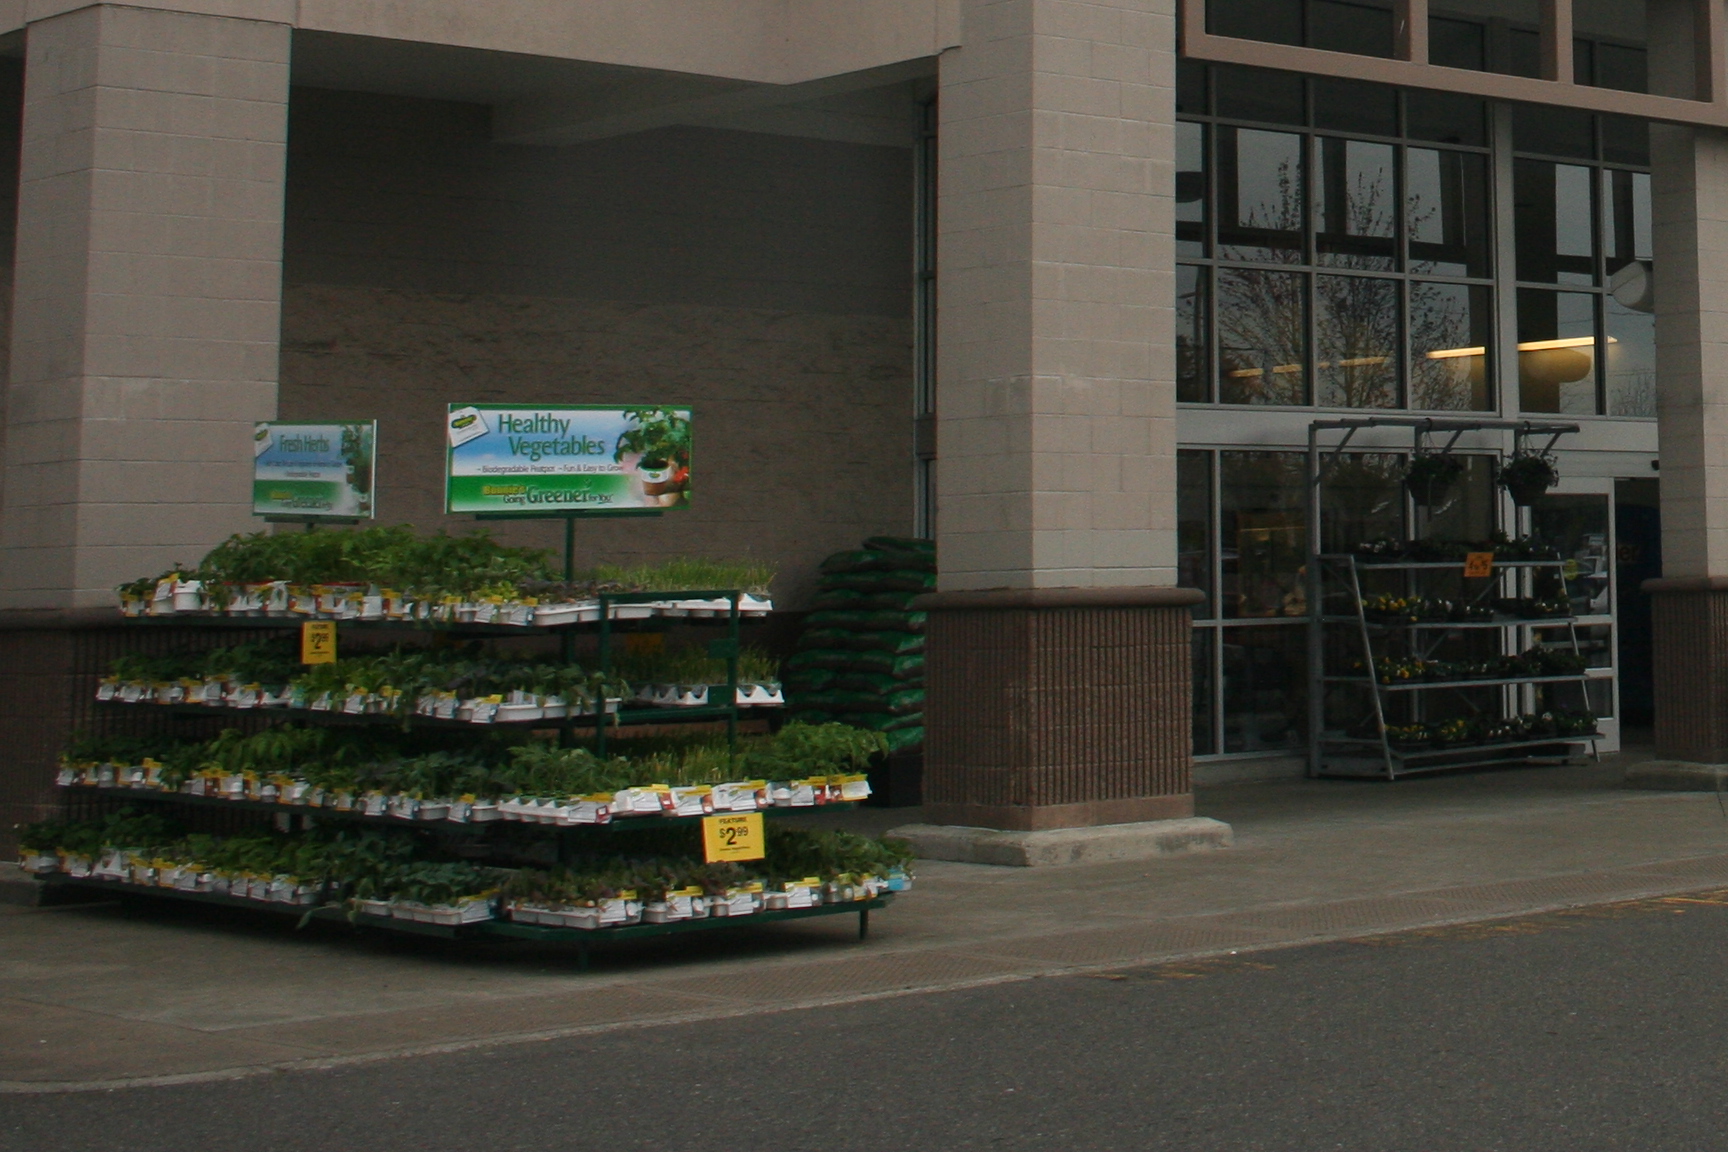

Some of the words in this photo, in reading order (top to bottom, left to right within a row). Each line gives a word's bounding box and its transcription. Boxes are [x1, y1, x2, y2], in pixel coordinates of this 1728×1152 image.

[498, 413, 571, 439] Healthy
[508, 435, 606, 461] Vegetables
[527, 486, 590, 504] Greener
